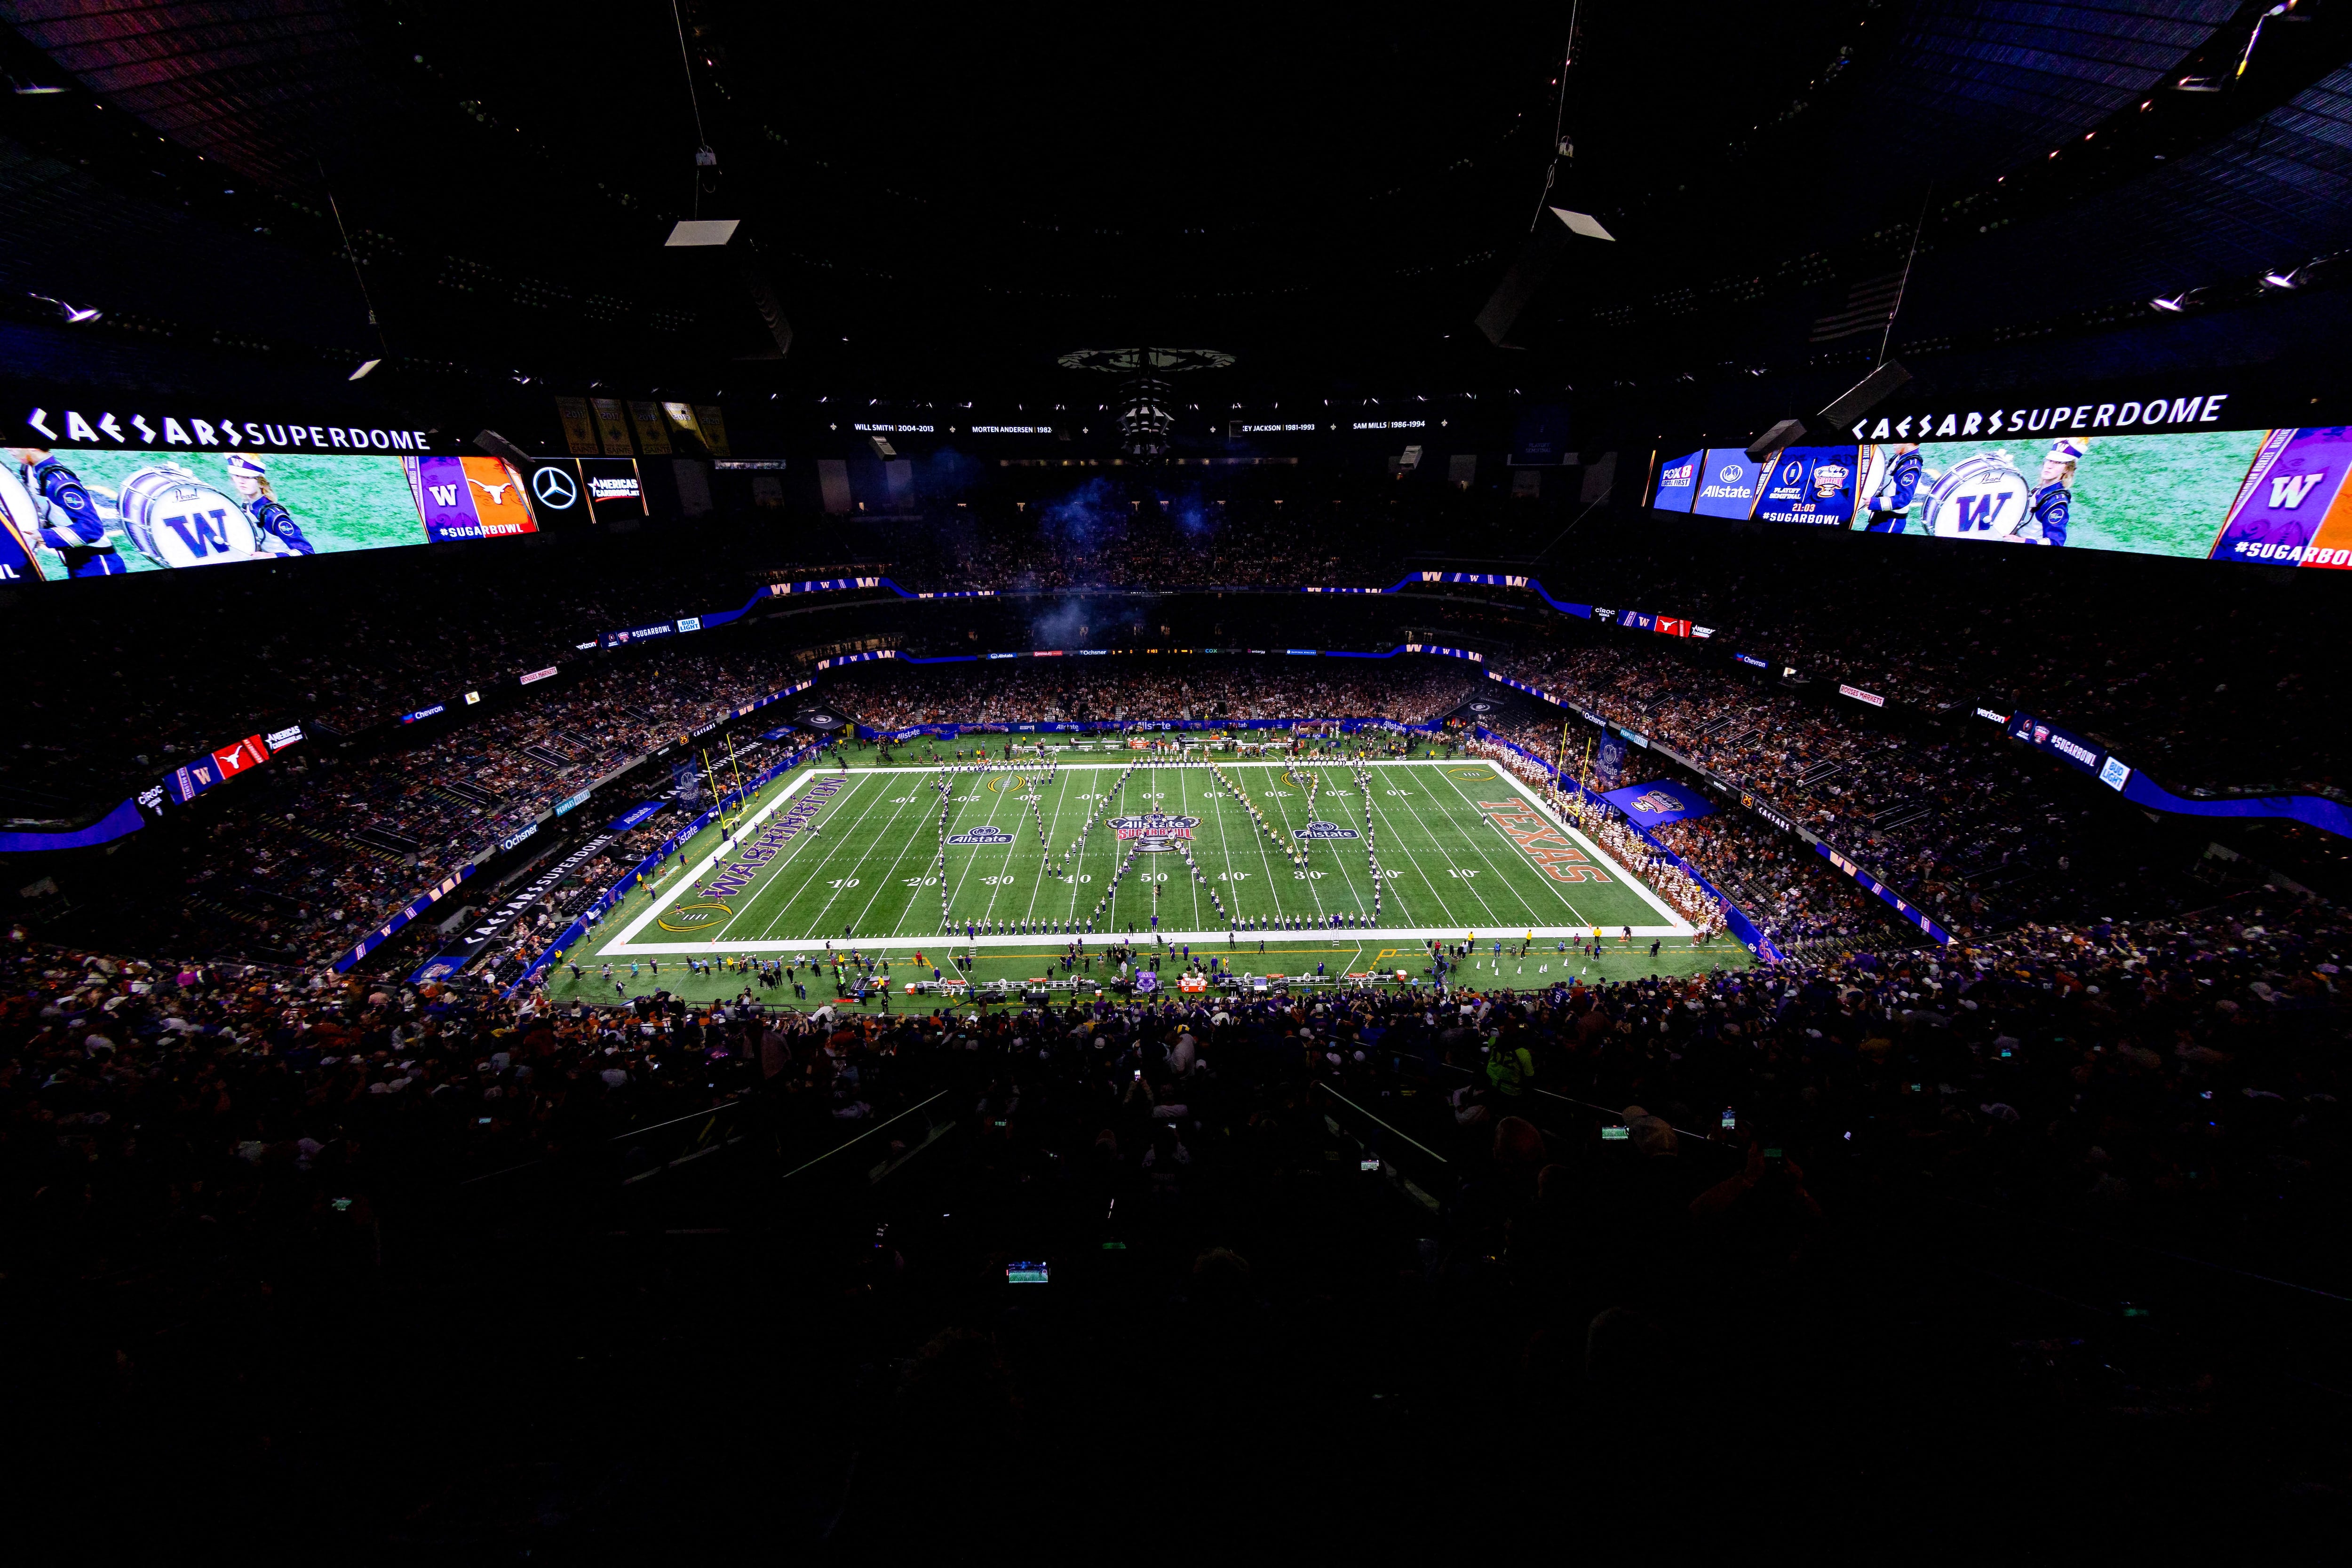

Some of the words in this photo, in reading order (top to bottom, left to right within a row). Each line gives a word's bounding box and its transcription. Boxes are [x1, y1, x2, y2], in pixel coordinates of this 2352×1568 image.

[1851, 410, 2004, 441] CAESARS
[2006, 395, 2229, 432] SUPERDOME
[27, 408, 243, 446] CAESARS
[243, 422, 431, 450] SUPERDOME
[1663, 467, 1682, 479] FOX
[1681, 465, 1692, 478] 8
[1980, 471, 2002, 484] Pearl
[596, 478, 638, 489] AMERICAS
[173, 487, 200, 503] Pearl
[429, 484, 458, 506] W
[2268, 473, 2325, 509] W
[1792, 503, 1816, 512] 21:03
[1956, 492, 2013, 532] W
[1763, 512, 1840, 525] #SUGARBOWL
[163, 508, 230, 558] W
[439, 523, 524, 537] #SUGARBOWL
[1638, 617, 1650, 626] W
[632, 625, 671, 638] #SUGARBOWL
[1744, 656, 1766, 668] Chevron
[521, 673, 537, 683] ROUSES
[538, 667, 556, 678] MARKETS
[1840, 685, 1859, 697] ROUSES
[1859, 690, 1883, 705] MARKETS
[415, 705, 443, 720] Chevron
[1584, 712, 1606, 727] Ochsner
[1977, 708, 2005, 724] verizon
[693, 723, 716, 737] CAESARS
[1383, 721, 1406, 733] Allstate
[680, 736, 688, 745] 25
[897, 729, 921, 741] Allstate
[1620, 728, 1635, 741] PEOPLES
[1636, 735, 1648, 747] HEALTH
[708, 741, 763, 770] SUPERDOME
[2051, 734, 2097, 767] #SUGARBOWL
[2109, 761, 2124, 776] BUD
[193, 767, 211, 785] W
[2102, 769, 2122, 787] LIGHT
[556, 799, 574, 816] PEOPLES
[575, 791, 590, 805] HEALTH
[1743, 795, 1752, 806] 25
[623, 806, 652, 824] Allstate
[1758, 807, 1789, 831] CAESARS
[506, 824, 537, 850] Ochsner
[698, 777, 849, 898] WASHINGTON
[1298, 829, 1352, 837] Allstate
[1478, 798, 1613, 883] TEXAS
[986, 876, 1014, 885] 30
[1064, 874, 1092, 884] 40
[1140, 873, 1168, 882] 50
[1217, 872, 1245, 881] 40
[1294, 871, 1322, 880] 30
[1447, 869, 1476, 878] 10
[830, 879, 860, 888] 10
[907, 877, 937, 886] 20
[463, 886, 544, 944] CAESARS
[536, 834, 613, 885] SUPERDOME
[1897, 899, 1906, 911] W
[381, 924, 391, 937] W
[1748, 942, 1757, 952] GO
[1555, 994, 1561, 1003] 9
